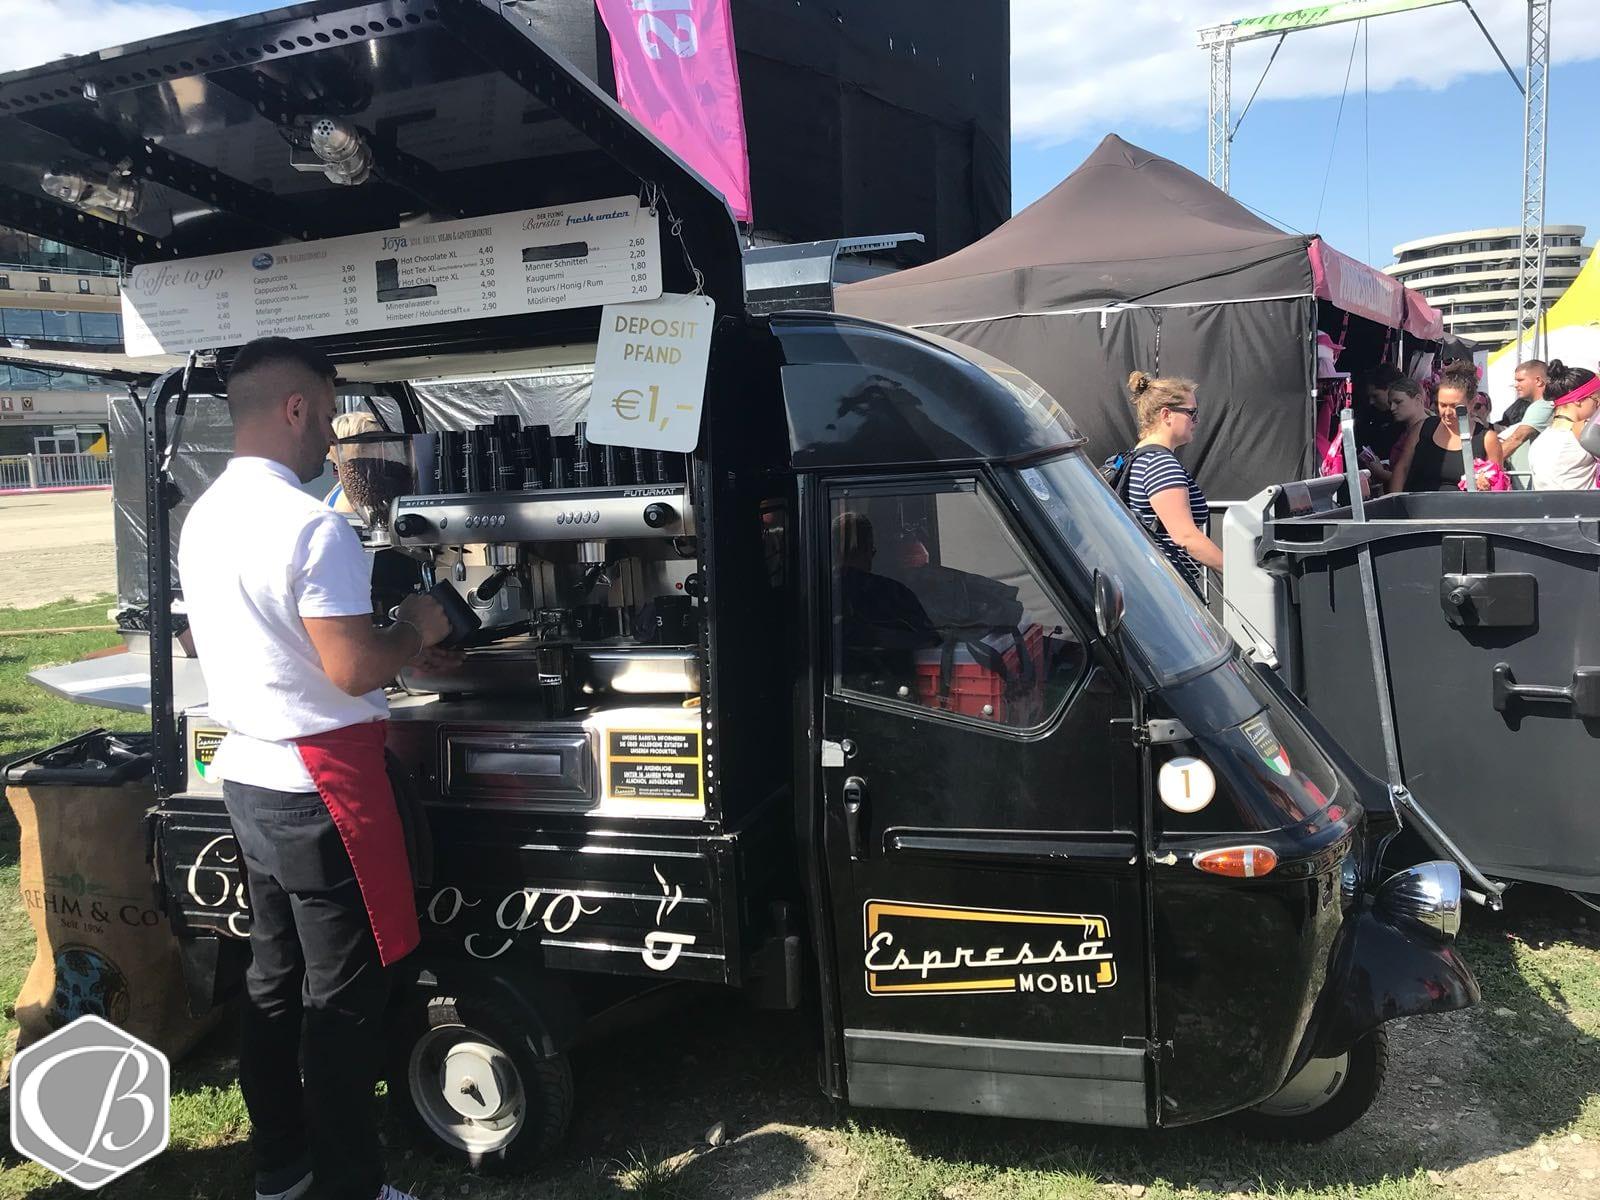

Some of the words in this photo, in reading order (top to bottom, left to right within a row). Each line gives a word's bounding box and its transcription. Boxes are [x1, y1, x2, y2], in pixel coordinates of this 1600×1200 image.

[522, 217, 560, 231] Barista
[547, 210, 564, 218] FLYING
[629, 238, 645, 247] 2,60
[401, 256, 412, 264] Hot
[414, 252, 447, 261] Chocolate
[449, 250, 458, 258] XL
[478, 246, 494, 255] 4,40
[525, 262, 552, 272] Manner
[554, 257, 588, 268] Schnitten
[629, 250, 646, 259] 2,20
[253, 275, 288, 285] Cappuccino
[342, 264, 355, 273] 3,90
[401, 267, 414, 275] Hot
[428, 264, 437, 272] XL
[480, 257, 494, 266] 3,50
[526, 271, 565, 283] Kaugummi
[630, 262, 646, 271] 1,80
[135, 265, 180, 296] Coffee
[184, 269, 199, 284] to
[198, 267, 224, 290] go
[254, 286, 288, 295] Cappuccino
[342, 275, 356, 284] 4,90
[402, 279, 414, 287] Hot
[415, 277, 431, 285] Chai
[431, 275, 449, 283] Latte
[450, 273, 460, 281] XL
[480, 268, 495, 277] 4,50
[480, 280, 496, 289] 4,90
[526, 284, 556, 294] Flavours
[560, 282, 582, 293] Honig
[587, 279, 604, 287] Rum
[630, 273, 647, 283] 0,80
[255, 296, 289, 305] Cappuccino
[343, 286, 357, 295] 4,90
[344, 297, 358, 305] 3,90
[385, 300, 432, 311] Mineralwasser
[481, 291, 497, 300] 2,90
[527, 294, 566, 306] Müsliriegel
[631, 285, 648, 294] 2,40
[297, 312, 330, 321] Americano
[386, 313, 414, 321] Himbeer
[419, 307, 463, 318] Holundersaft
[482, 302, 497, 311] 2,90
[274, 326, 305, 334] Macchiato
[614, 315, 698, 339] DEPOSIT
[623, 343, 682, 365] PFAND
[623, 488, 676, 497] FUTURMAT
[1181, 769, 1191, 798] 1
[91, 902, 111, 923] &
[61, 918, 79, 930] Seit
[464, 887, 602, 959] go
[865, 931, 1114, 979] Espresso
[1019, 973, 1096, 994] MOBIL
